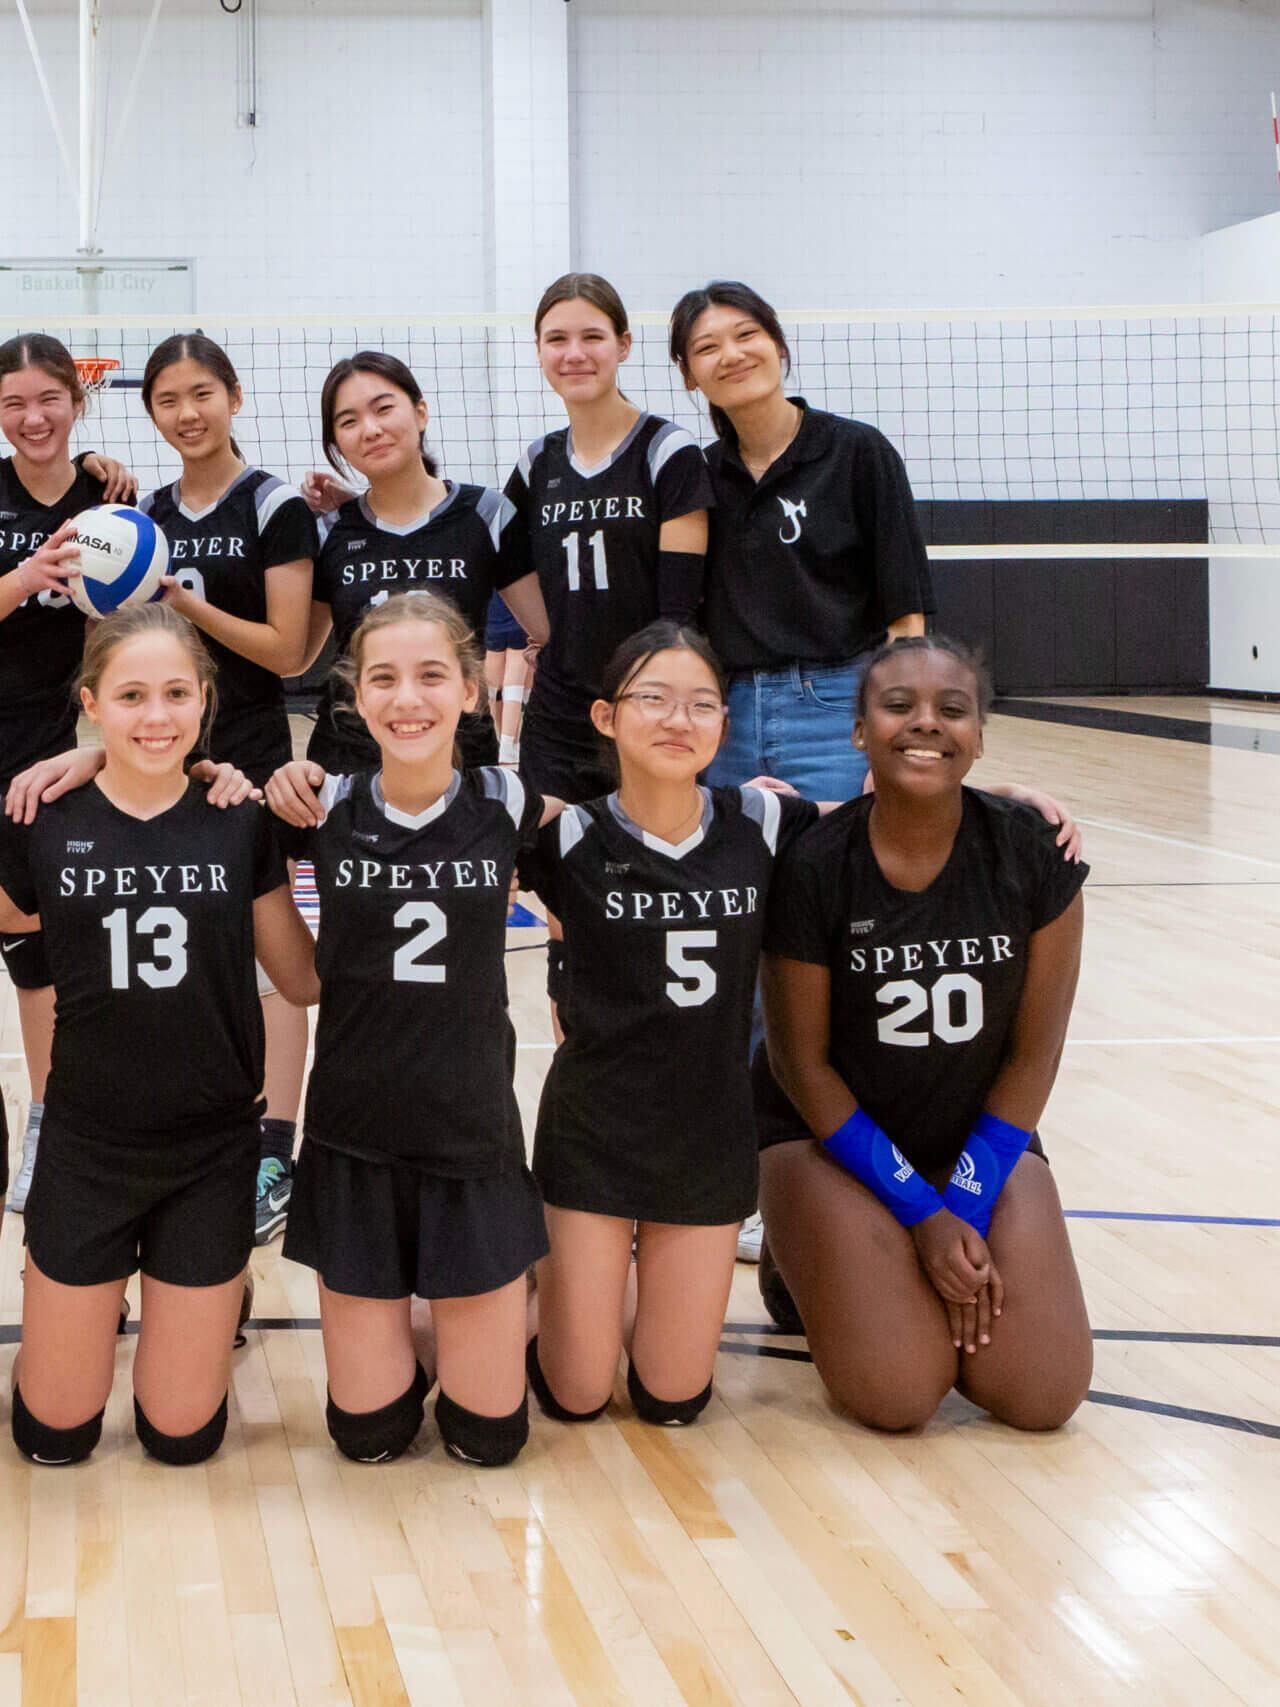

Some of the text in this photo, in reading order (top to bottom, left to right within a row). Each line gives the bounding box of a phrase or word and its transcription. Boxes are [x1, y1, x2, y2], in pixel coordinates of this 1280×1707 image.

[21, 273, 156, 294] Basketall City
[542, 496, 646, 527] SPEYER
[342, 558, 468, 585] SPEYER
[561, 529, 609, 592] 11
[59, 863, 229, 897] SPEYER
[335, 859, 499, 889] SPEYER
[605, 886, 759, 920] SPEYER
[101, 906, 188, 990] 13
[393, 901, 448, 984] 2
[850, 934, 1014, 974] SPEYER
[665, 929, 718, 1008] 5
[875, 972, 984, 1047] 20
